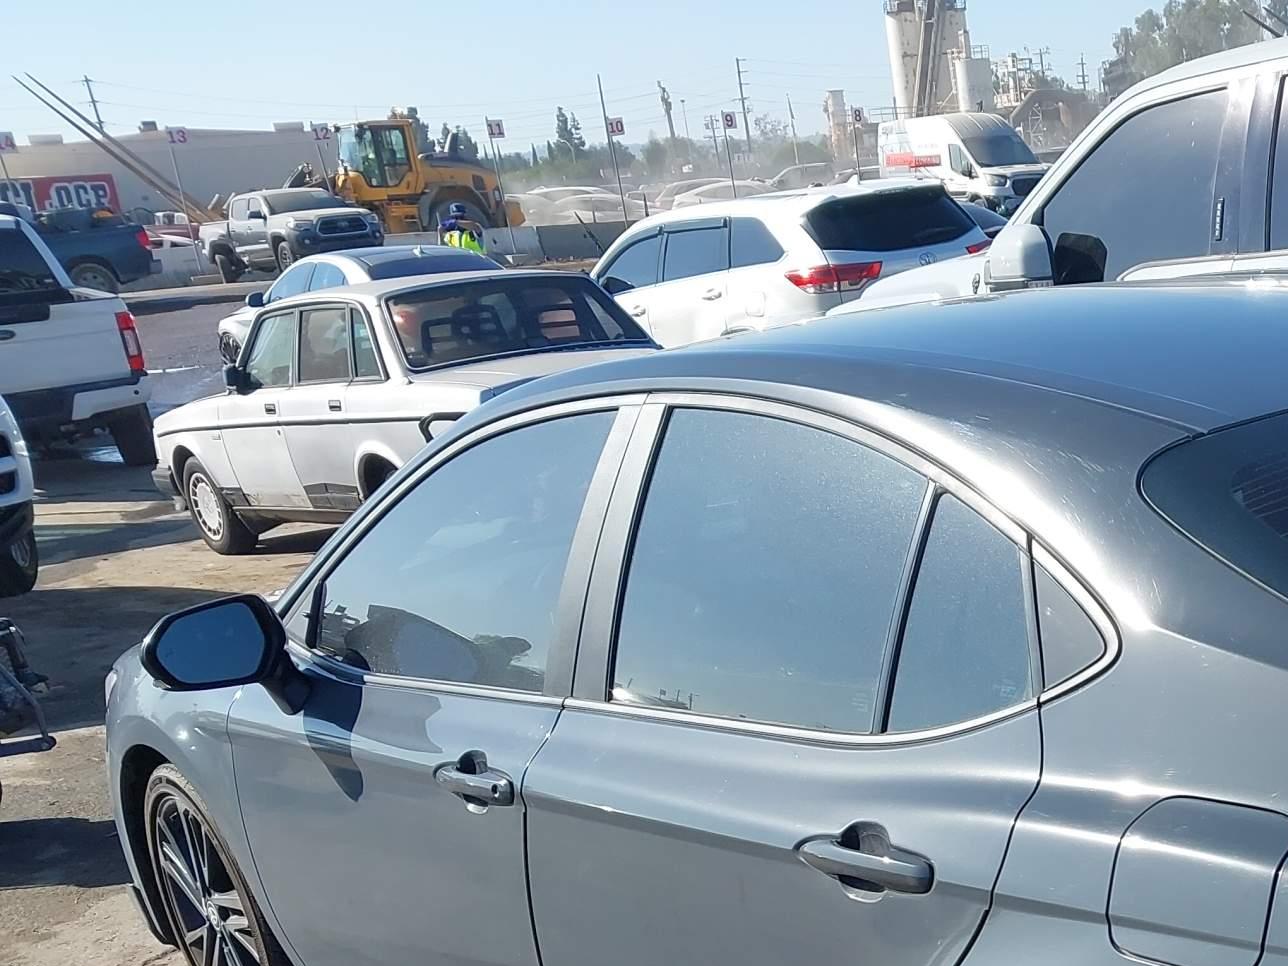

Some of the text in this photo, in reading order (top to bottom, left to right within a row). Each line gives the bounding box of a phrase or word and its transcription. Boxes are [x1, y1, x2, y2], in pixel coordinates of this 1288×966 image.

[724, 113, 735, 128] 9
[854, 109, 862, 122] 8
[312, 127, 332, 141] 12
[487, 123, 505, 136] 11
[608, 121, 624, 134] 10
[0, 136, 16, 150] 4
[168, 130, 188, 144] 13
